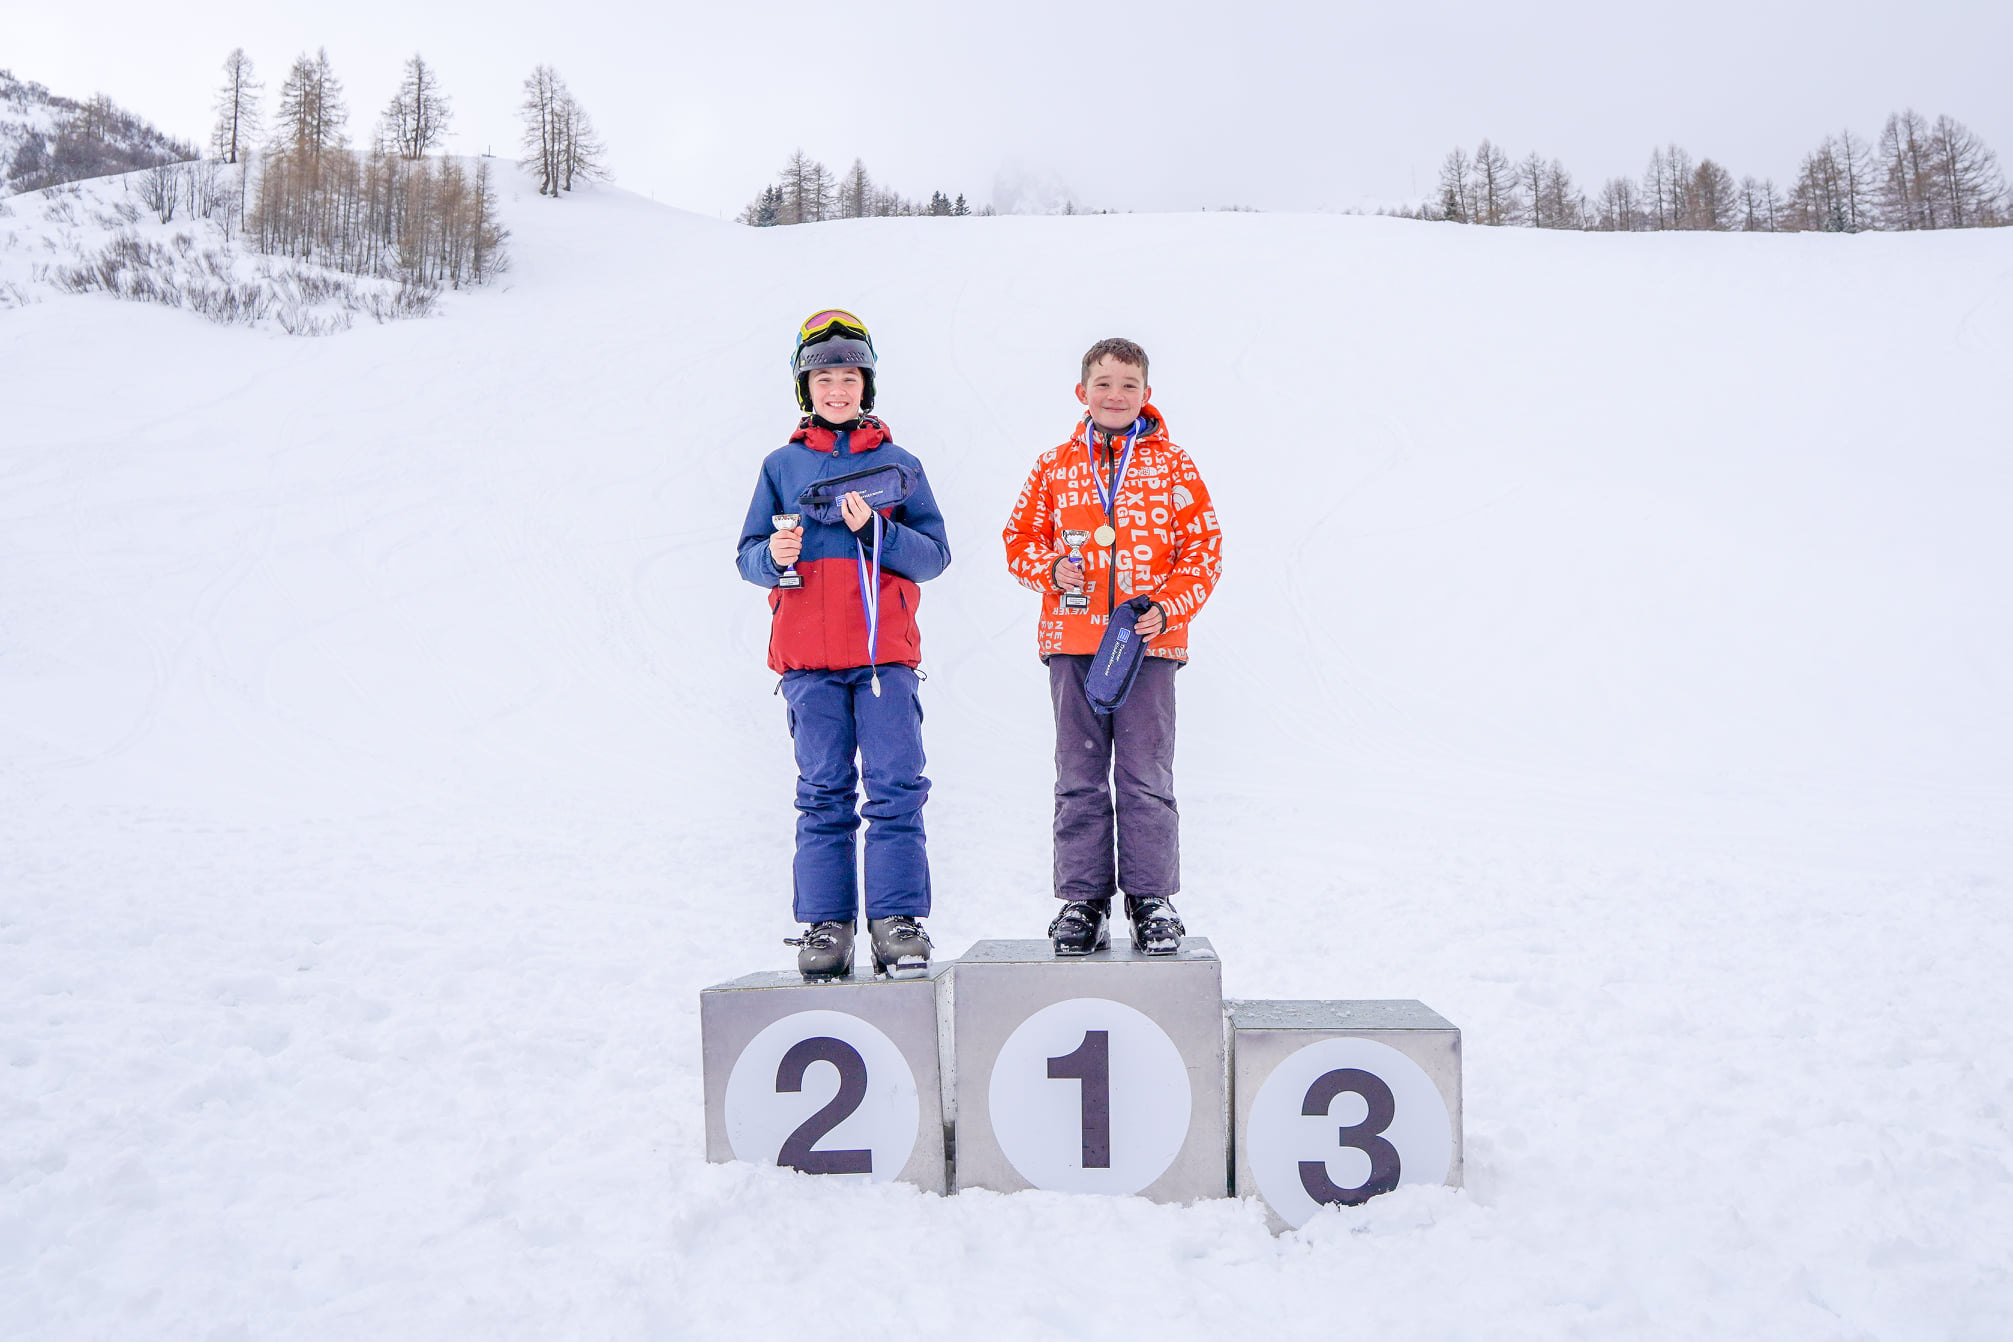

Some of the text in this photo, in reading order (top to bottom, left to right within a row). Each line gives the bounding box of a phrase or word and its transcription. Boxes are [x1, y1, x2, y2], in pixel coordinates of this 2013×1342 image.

[776, 1037, 873, 1175] 2
[1047, 1030, 1110, 1169] 1
[1298, 1068, 1402, 1206] 3
